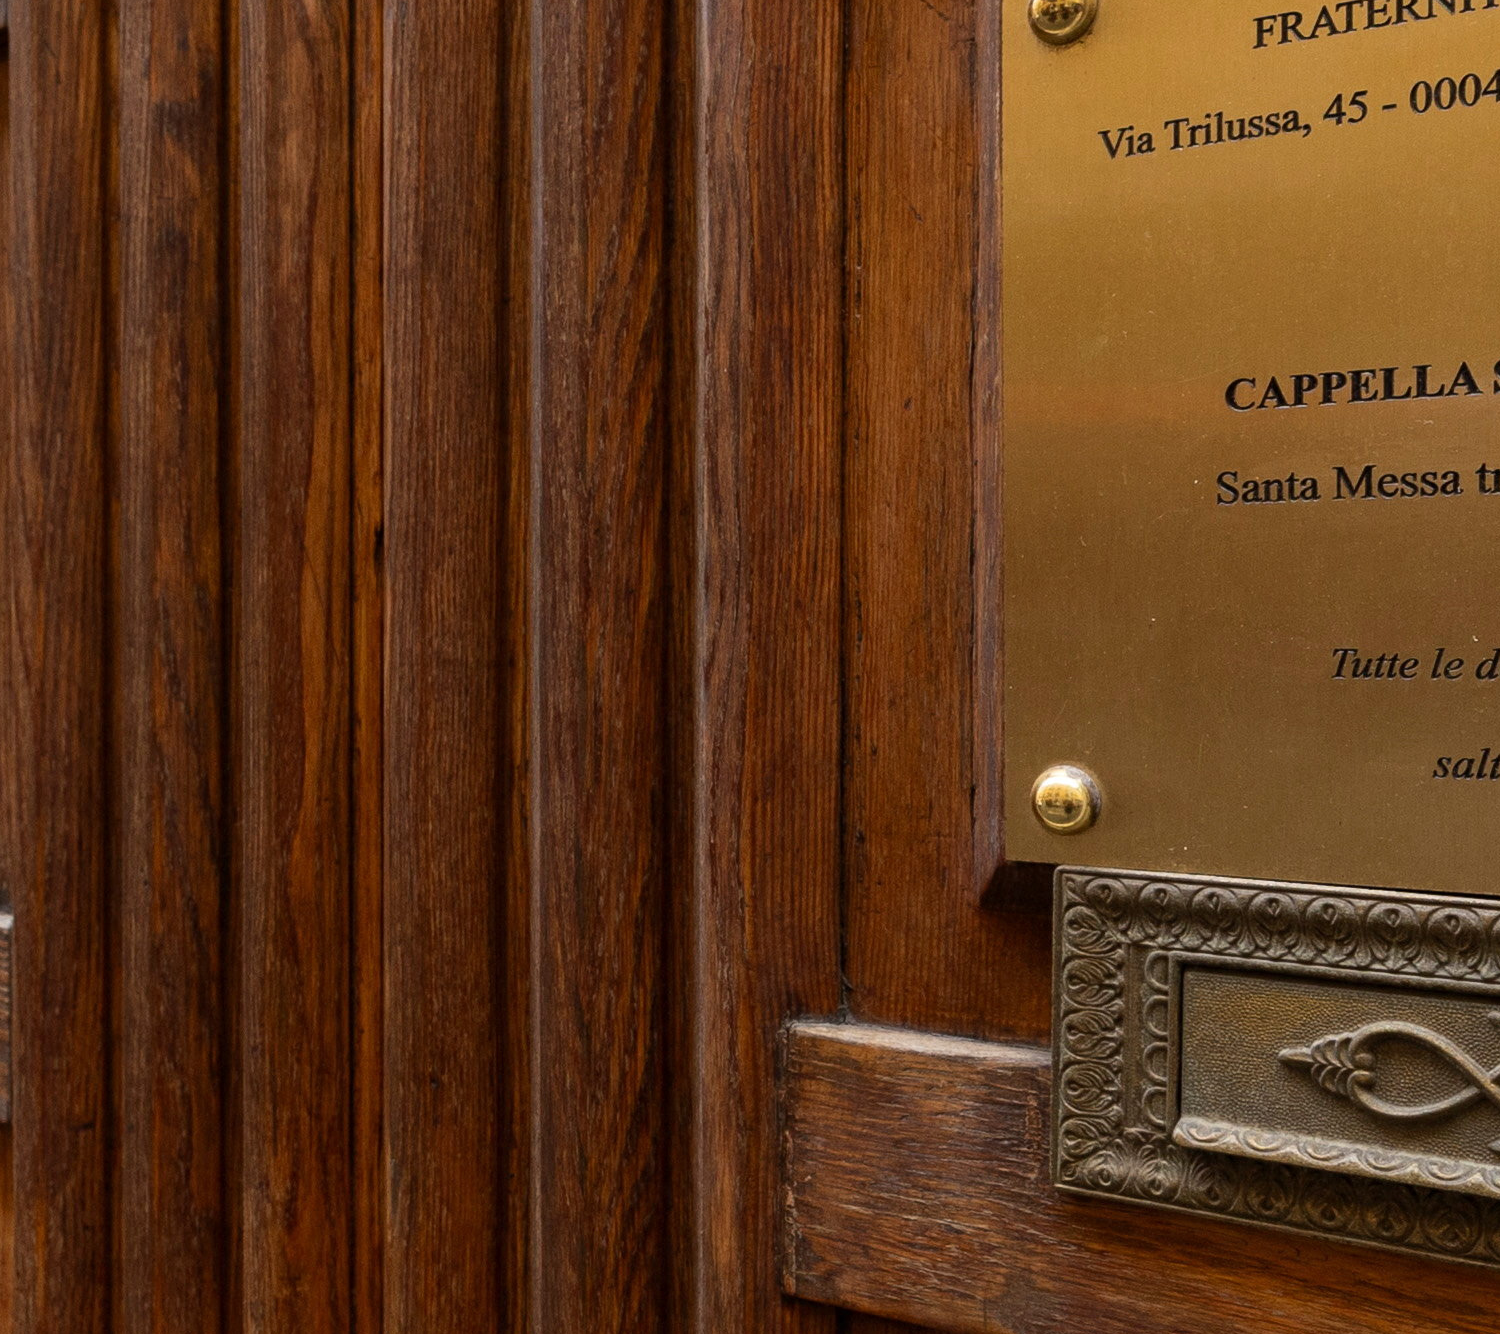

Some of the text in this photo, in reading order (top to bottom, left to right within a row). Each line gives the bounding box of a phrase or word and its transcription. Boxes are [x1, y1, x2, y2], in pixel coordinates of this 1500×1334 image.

[1097, 124, 1156, 160] Via
[1163, 109, 1312, 151] Trilussa,
[1322, 89, 1369, 126] 45
[1381, 103, 1398, 111] -
[1224, 361, 1484, 411] CAPPELLA
[1216, 470, 1322, 505] Santa
[1331, 464, 1465, 500] Messa
[1330, 648, 1420, 679] Tutte
[1430, 647, 1465, 680] le
